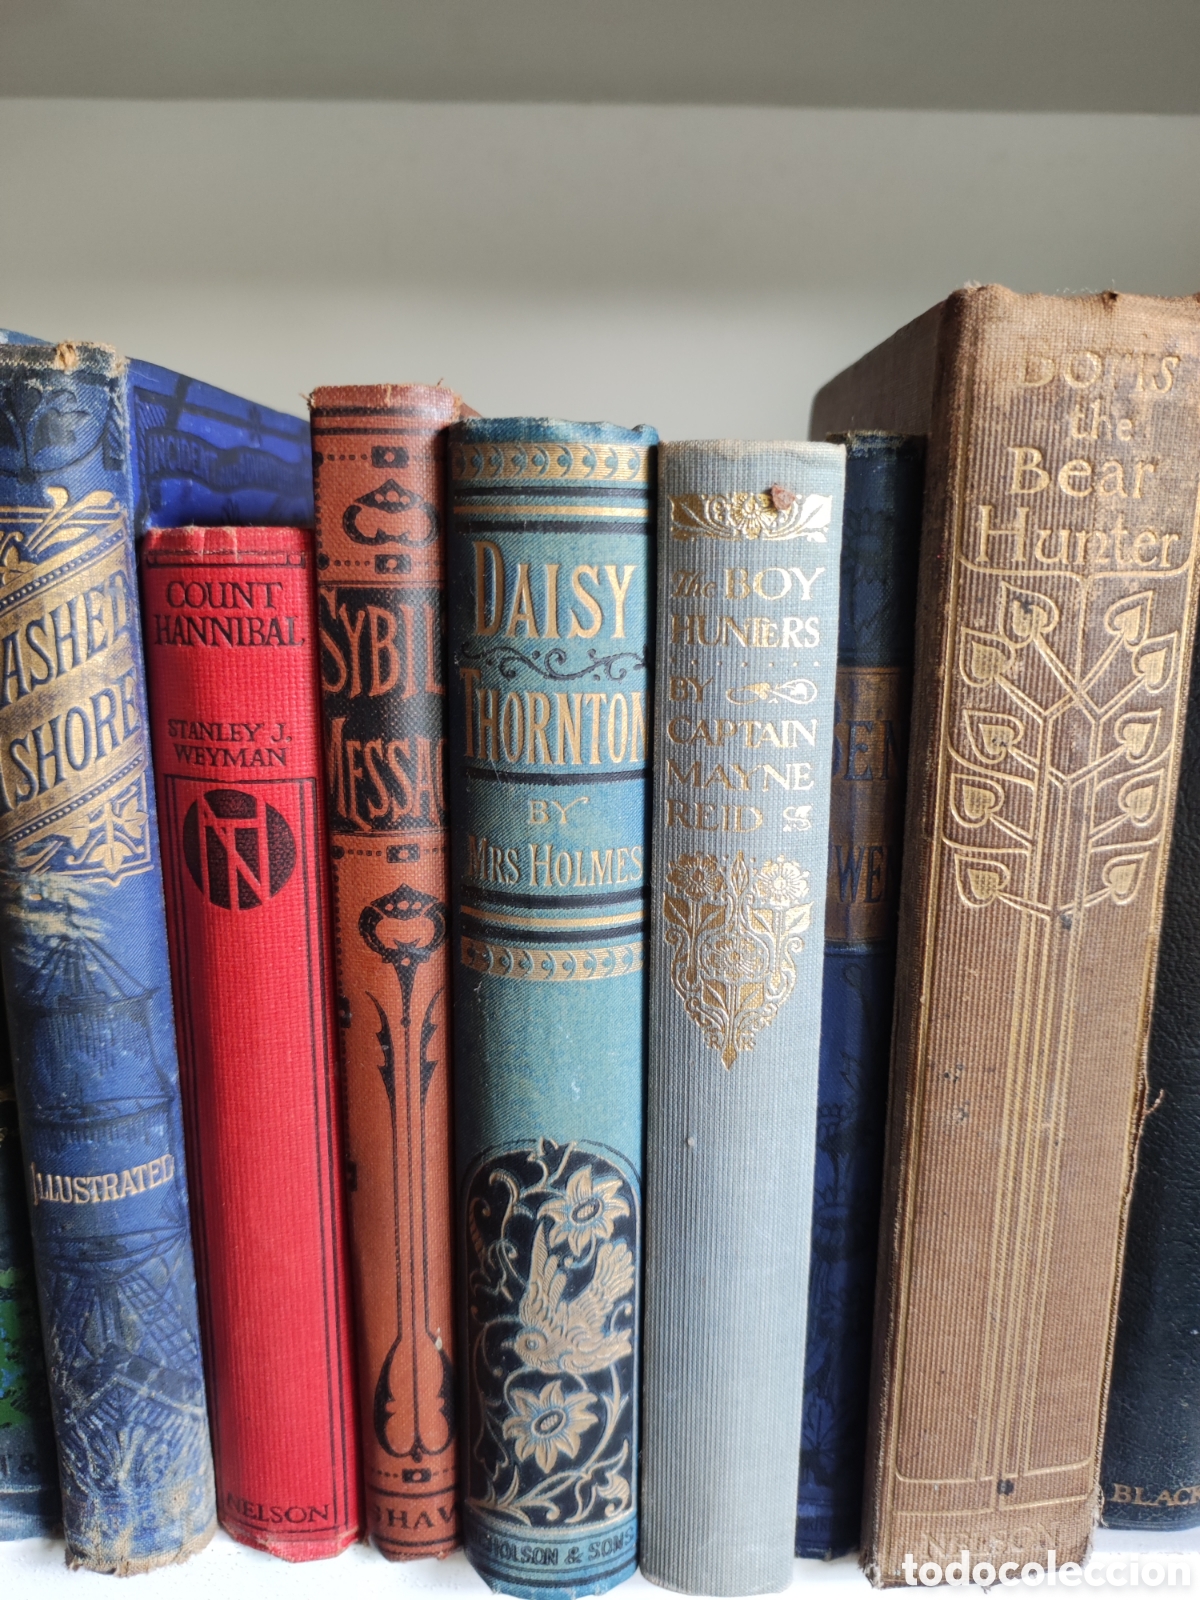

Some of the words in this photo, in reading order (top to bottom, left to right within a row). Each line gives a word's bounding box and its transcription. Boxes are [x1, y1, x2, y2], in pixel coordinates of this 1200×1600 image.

[1070, 399, 1134, 442] the
[1006, 446, 1156, 498] Bear
[974, 505, 1180, 567] Hunter
[166, 581, 284, 610] COUNT
[472, 540, 638, 639] DAISY
[670, 569, 717, 599] The
[724, 567, 826, 600] BOY
[154, 613, 305, 648] HANNIBAL
[669, 675, 714, 704] BY
[168, 718, 264, 743] STANLEY
[270, 722, 293, 744] J.
[459, 667, 649, 766] THORNTON
[666, 716, 818, 749] CAPTAIN
[173, 743, 288, 768] WEYMAN
[665, 758, 815, 792] MAYNE
[529, 796, 590, 825] BY
[665, 799, 764, 833] REID
[466, 834, 521, 884] MRS
[529, 843, 645, 887] HOLMES
[30, 1153, 175, 1206] ILLUSTRATED
[226, 1492, 329, 1524] NELSON
[1108, 1482, 1200, 1507] BLACK
[564, 1546, 584, 1564] &
[588, 1527, 636, 1560] SONS
